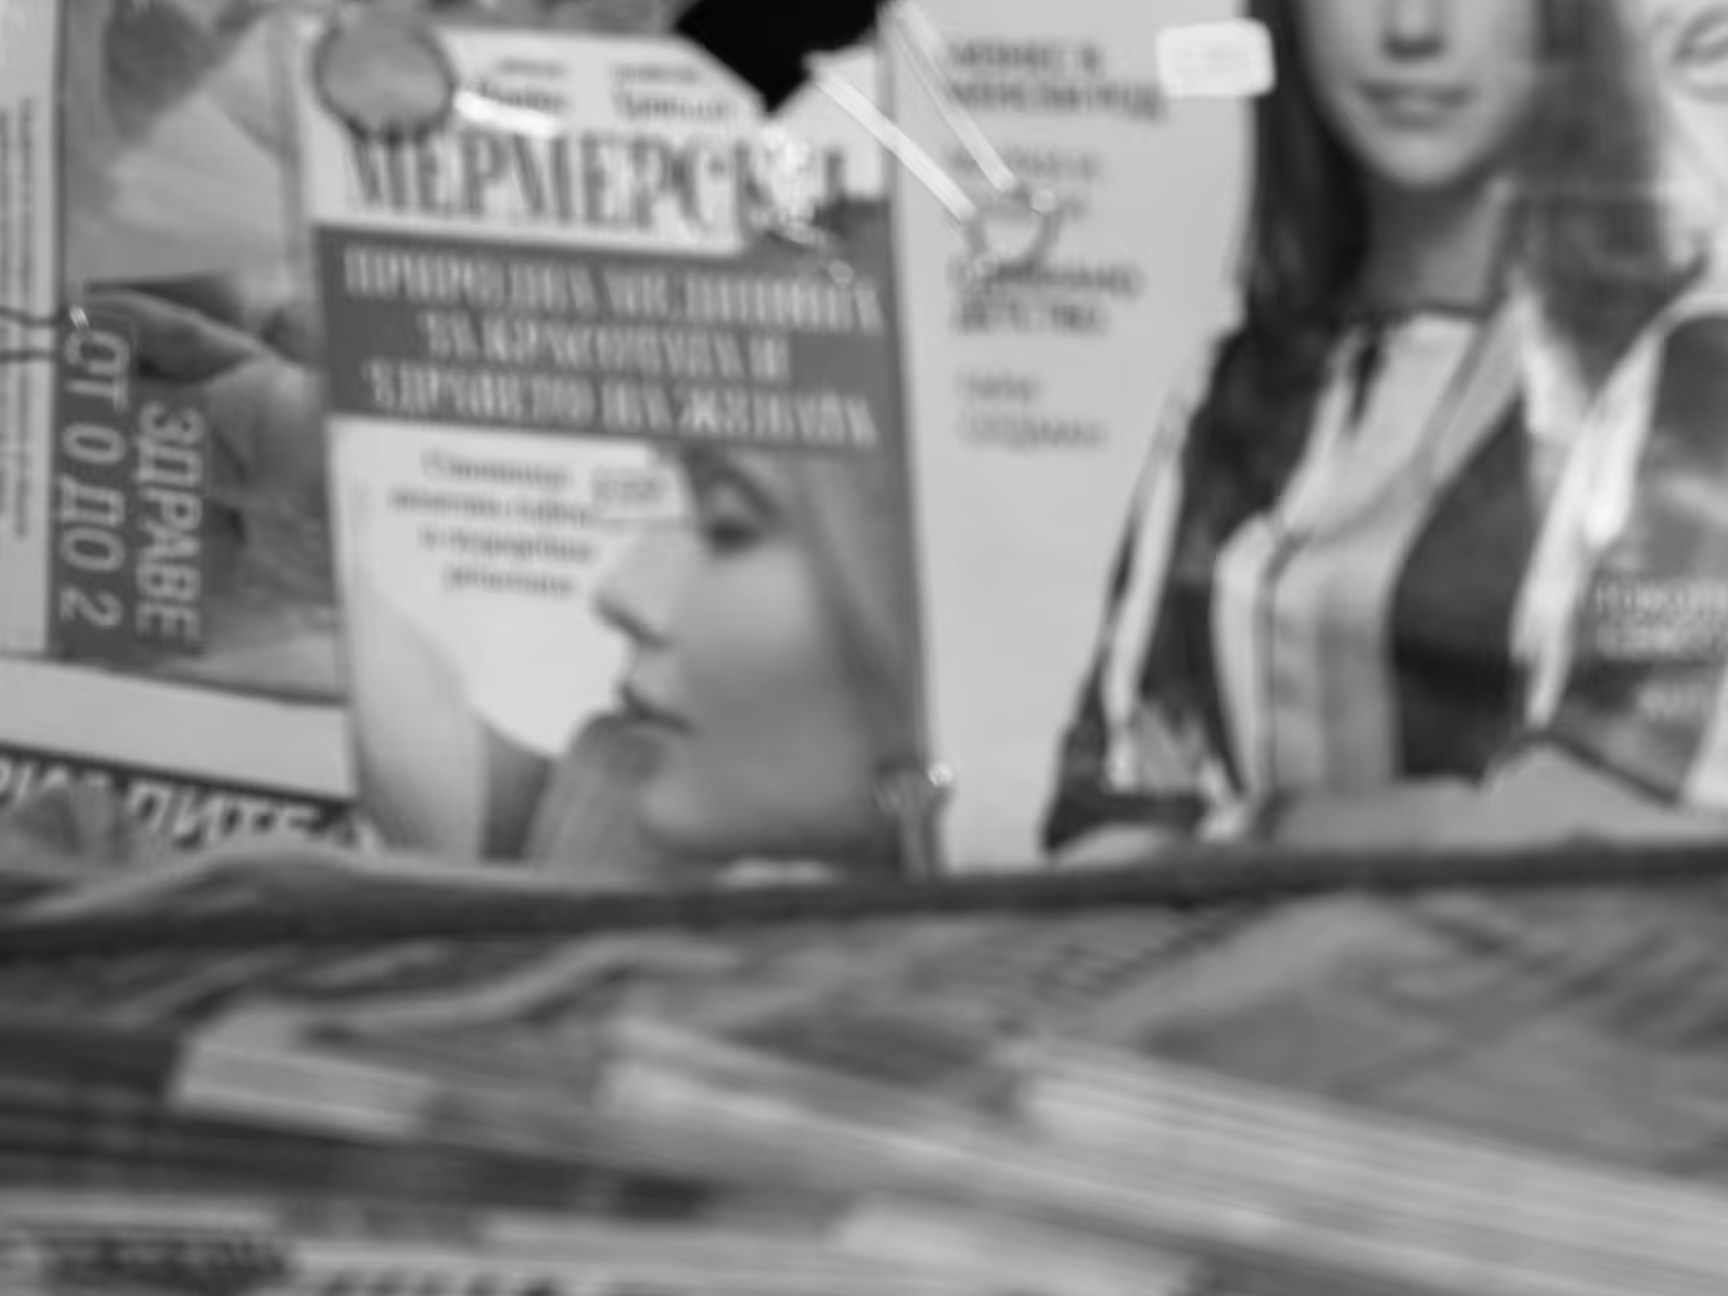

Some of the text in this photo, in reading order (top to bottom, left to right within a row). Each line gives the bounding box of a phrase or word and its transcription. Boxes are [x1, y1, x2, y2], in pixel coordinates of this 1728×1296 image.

[62, 329, 131, 412] ОТ
[58, 477, 127, 578] ДО
[135, 400, 205, 645] ЗДРАВЕ
[60, 585, 123, 629] 2
